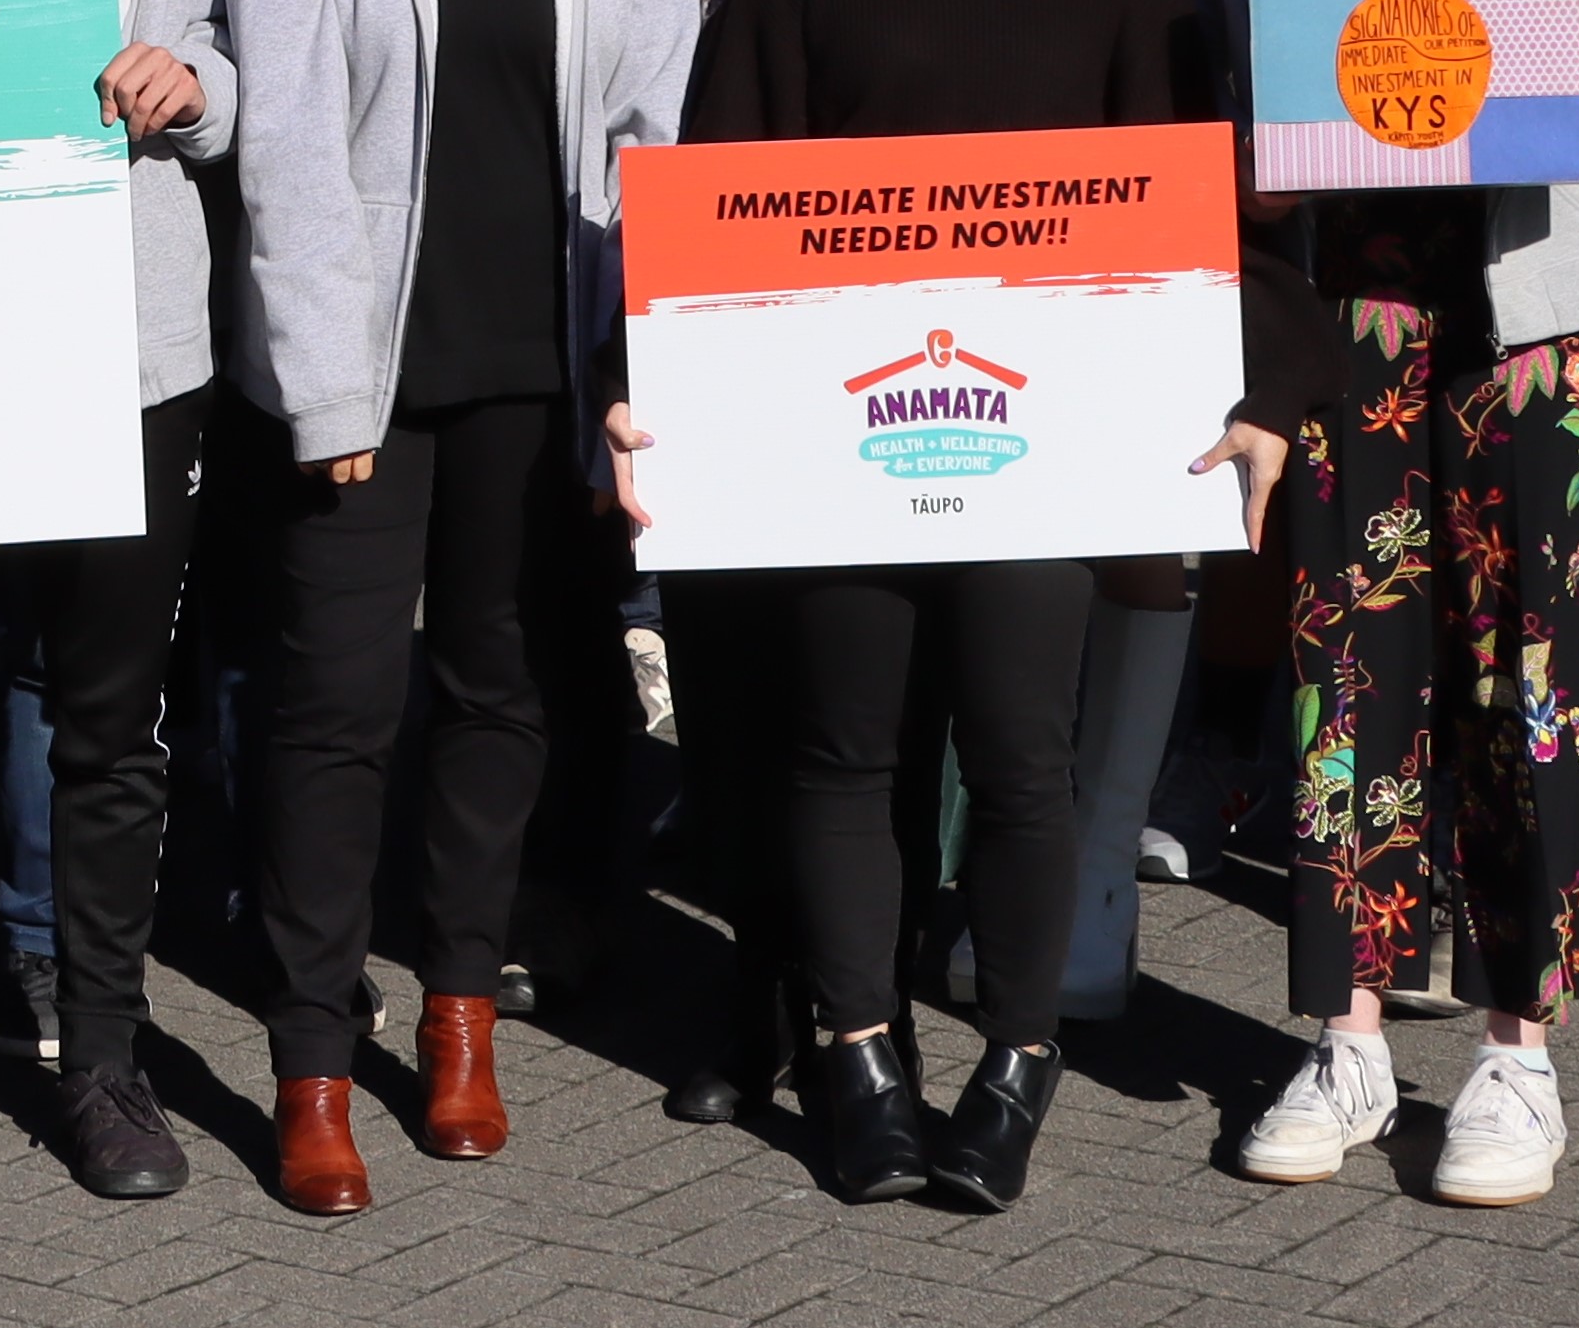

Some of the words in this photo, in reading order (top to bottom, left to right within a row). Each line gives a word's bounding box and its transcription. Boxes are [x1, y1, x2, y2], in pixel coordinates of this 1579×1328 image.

[1458, 11, 1477, 37] OF
[1341, 45, 1408, 68] IMMEDIATE
[1352, 69, 1449, 95] INVESTMENT
[1456, 68, 1473, 85] IN
[1372, 95, 1446, 131] KYS
[716, 186, 915, 221] IMMEDIATE
[927, 176, 1153, 211] INVESTMENT
[800, 225, 939, 256] NEEDED
[951, 217, 1070, 250] NOW!!
[868, 387, 1008, 429] ANAMATA
[869, 438, 925, 457] HEALTH
[940, 436, 1021, 456] WELLBEING
[893, 457, 914, 473] for
[917, 456, 993, 472] EVERYONE
[910, 493, 964, 515] TĀUPO
